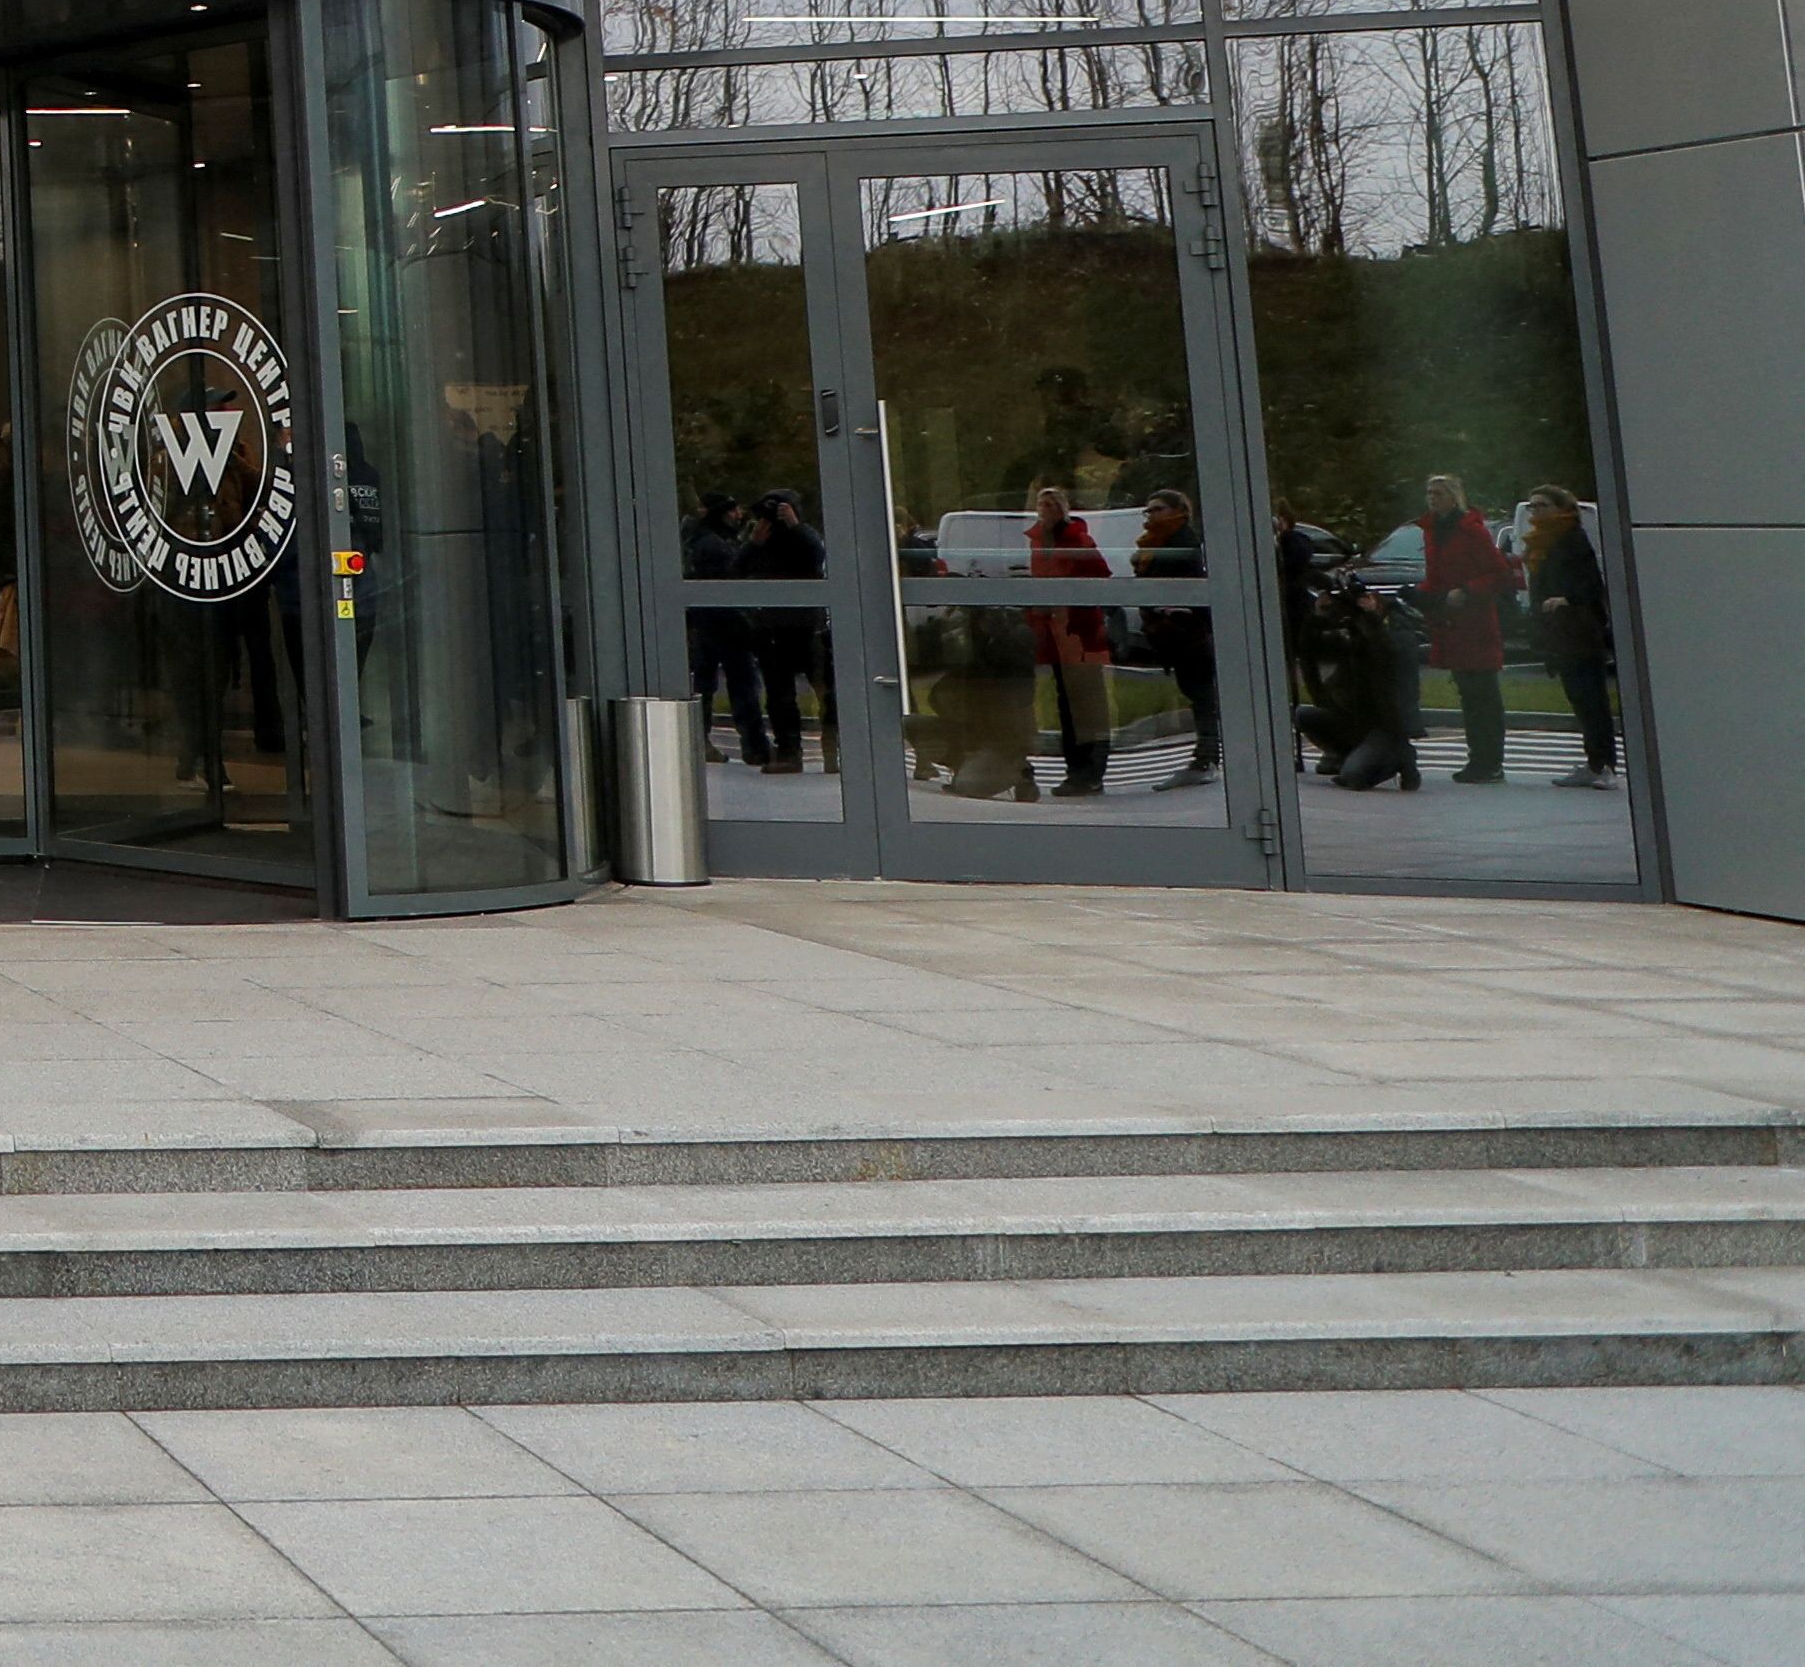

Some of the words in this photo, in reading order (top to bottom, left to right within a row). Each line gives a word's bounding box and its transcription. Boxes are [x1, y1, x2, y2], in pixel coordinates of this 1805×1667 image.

[108, 359, 143, 434] ЧВК
[136, 305, 229, 367] ВАГНЕР
[154, 410, 244, 495] W
